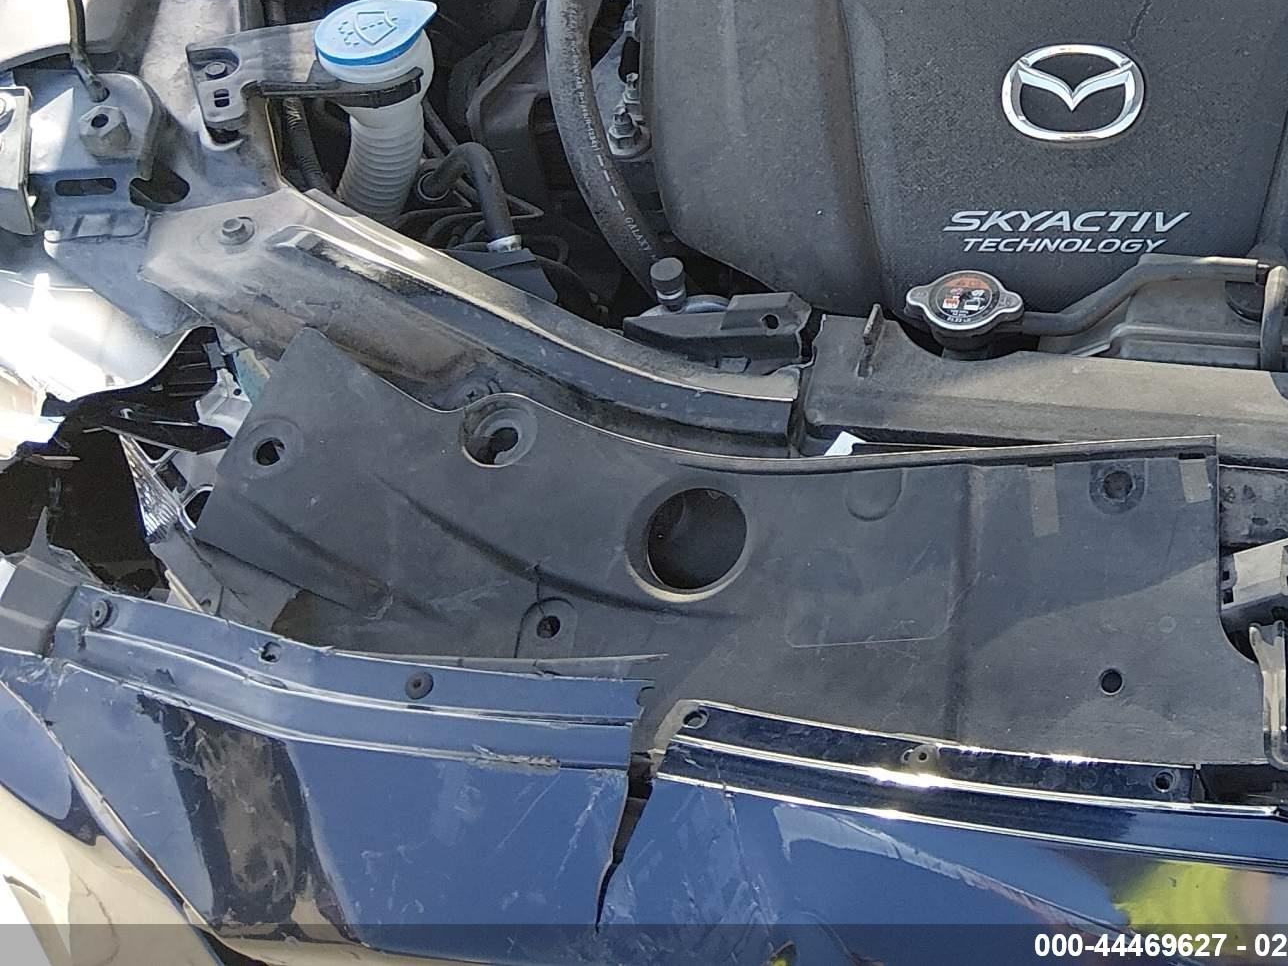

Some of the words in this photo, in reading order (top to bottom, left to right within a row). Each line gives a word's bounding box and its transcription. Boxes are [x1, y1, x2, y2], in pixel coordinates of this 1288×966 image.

[942, 210, 1191, 233] SKYACTIV
[625, 216, 652, 252] GALAXY
[963, 237, 1167, 253] TECHNOLOGY
